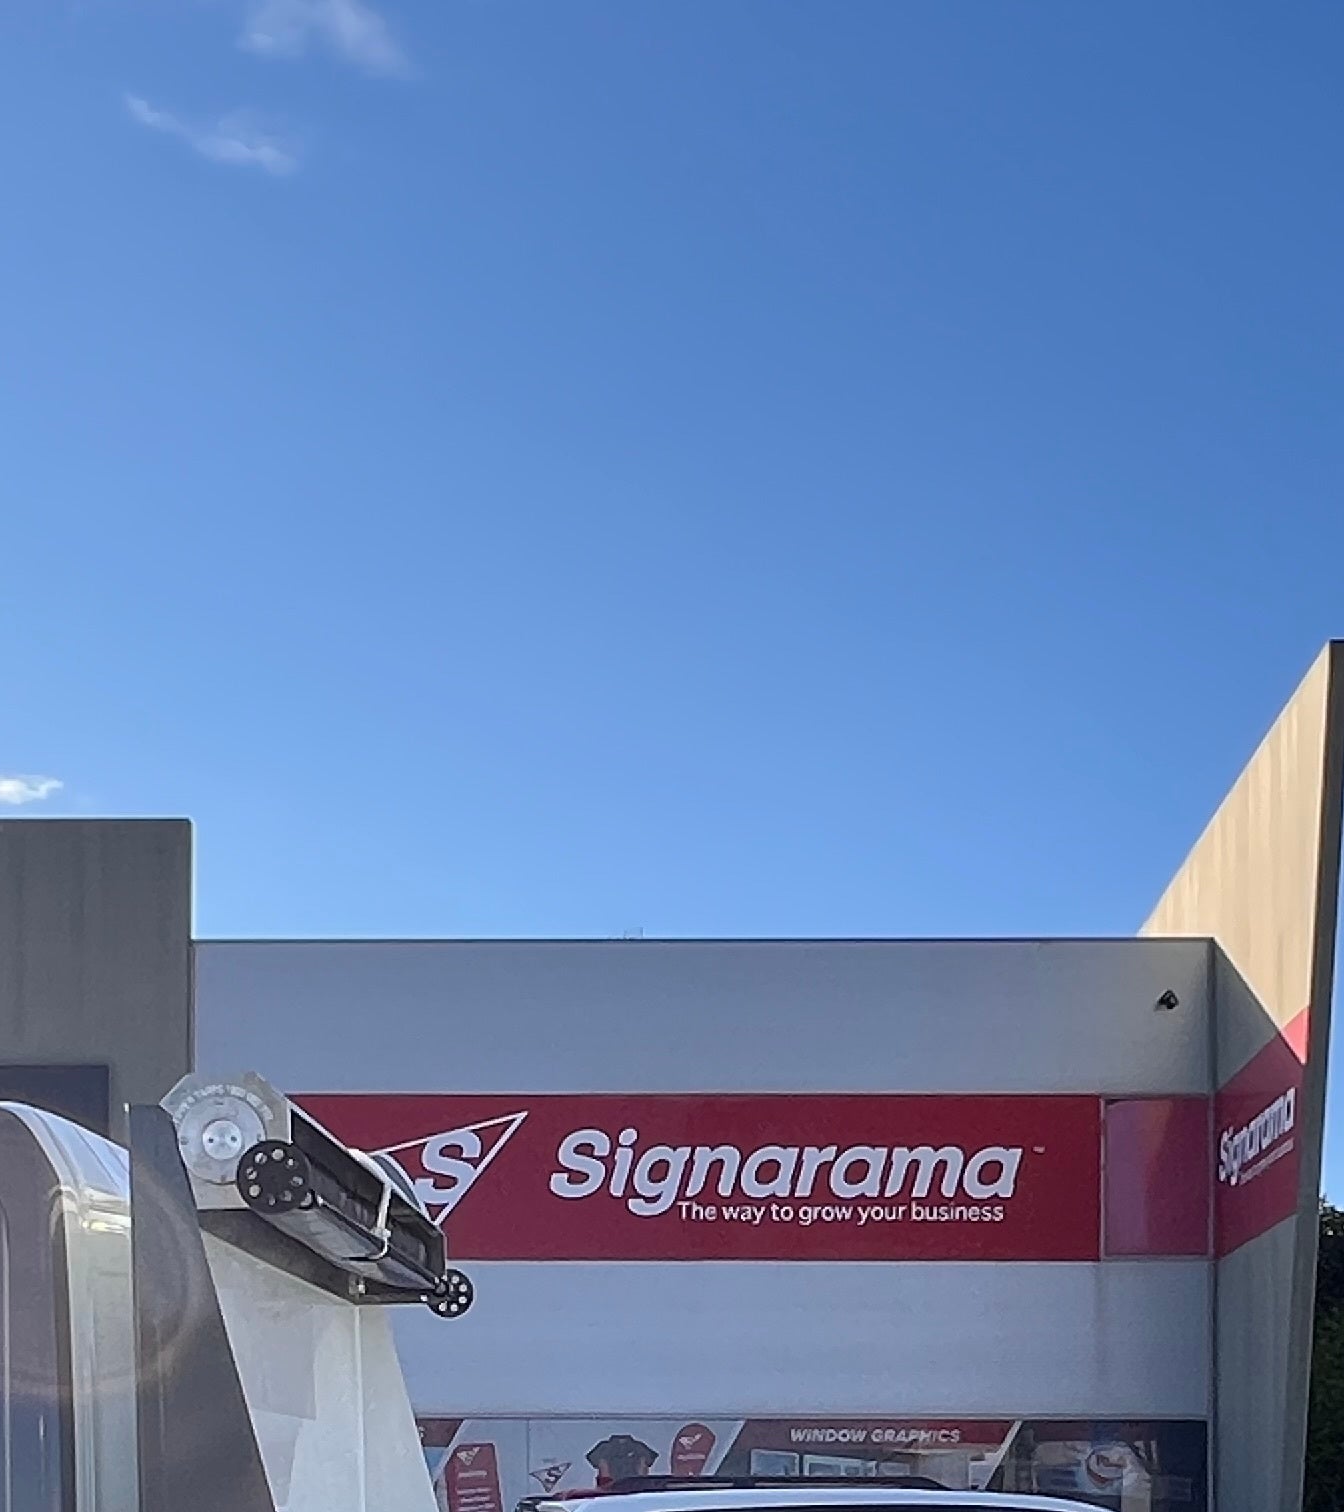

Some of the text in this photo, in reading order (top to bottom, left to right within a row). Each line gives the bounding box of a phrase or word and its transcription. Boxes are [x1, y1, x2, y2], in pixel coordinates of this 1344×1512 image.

[549, 1128, 1024, 1216] Signarama
[678, 1201, 1005, 1226] The way to grow your business
[790, 1428, 961, 1442] WINDOW GRAPHICS
